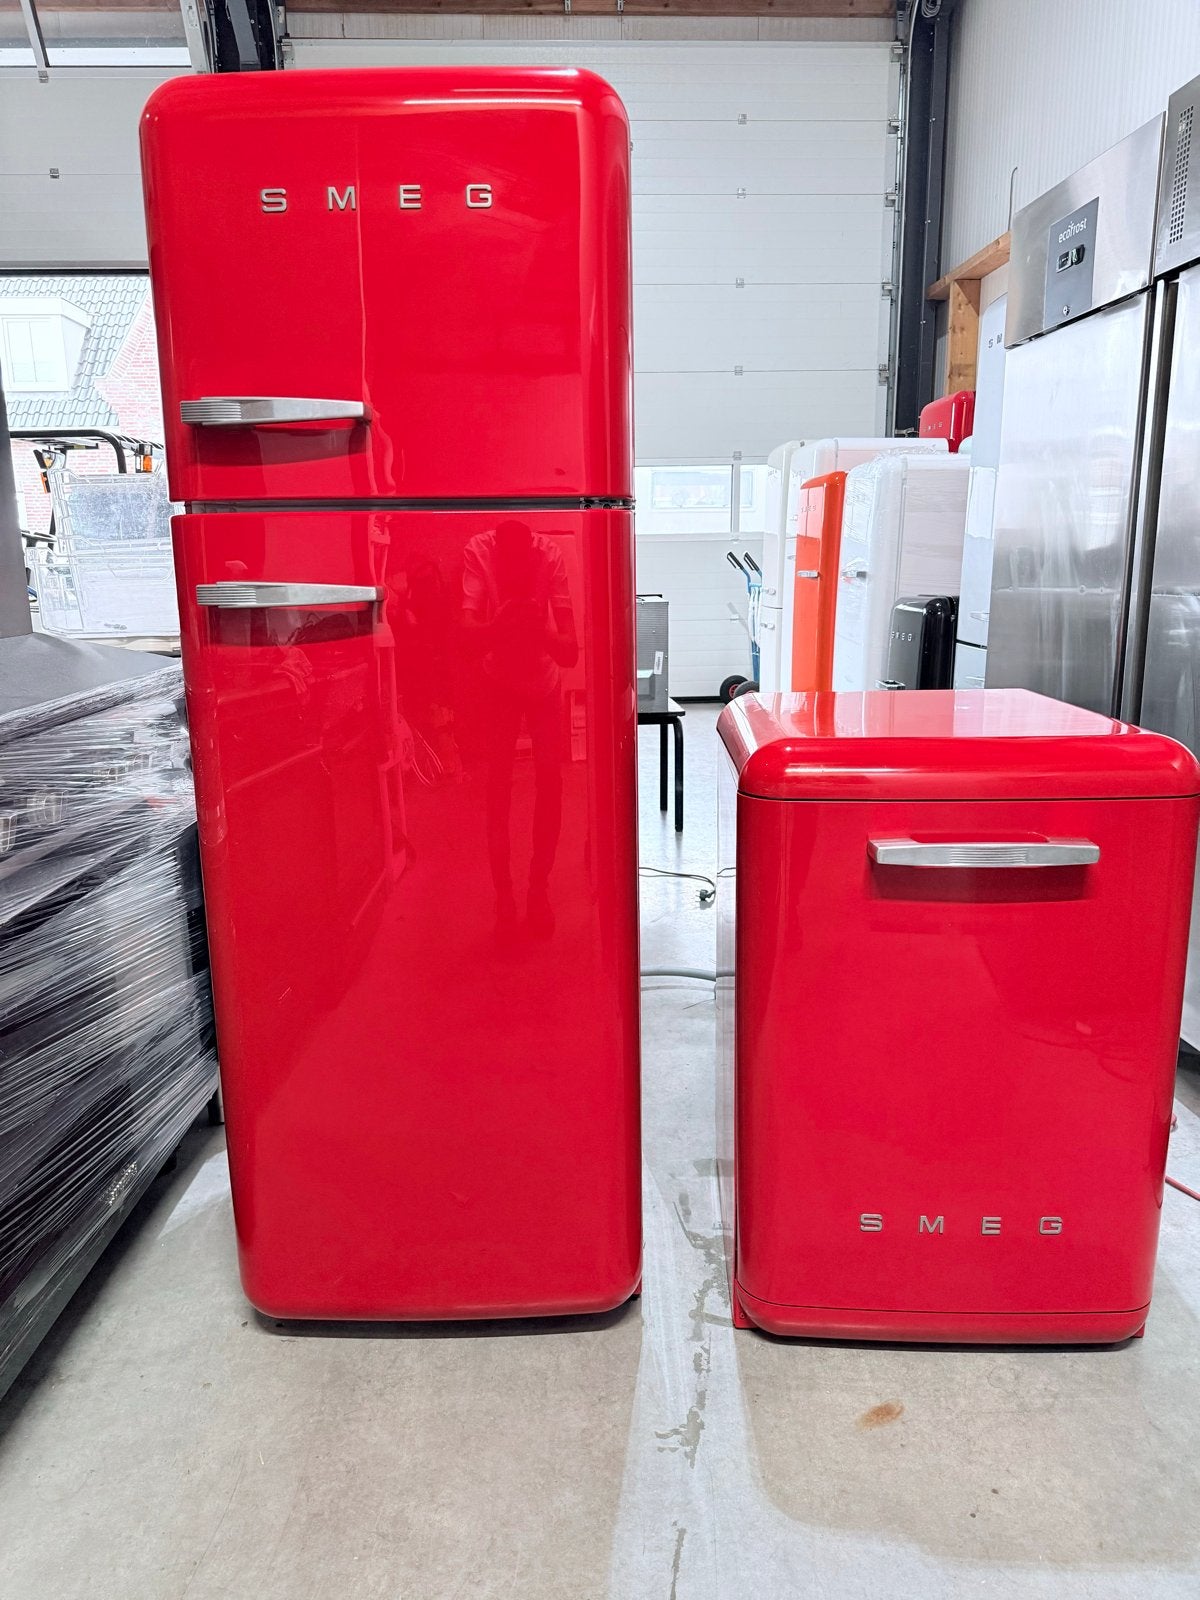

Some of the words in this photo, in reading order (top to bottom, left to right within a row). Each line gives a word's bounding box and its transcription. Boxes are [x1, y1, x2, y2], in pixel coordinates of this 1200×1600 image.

[260, 184, 493, 212] SMEG
[1058, 218, 1087, 243] ecofrost
[860, 1213, 1063, 1235] SMEG
